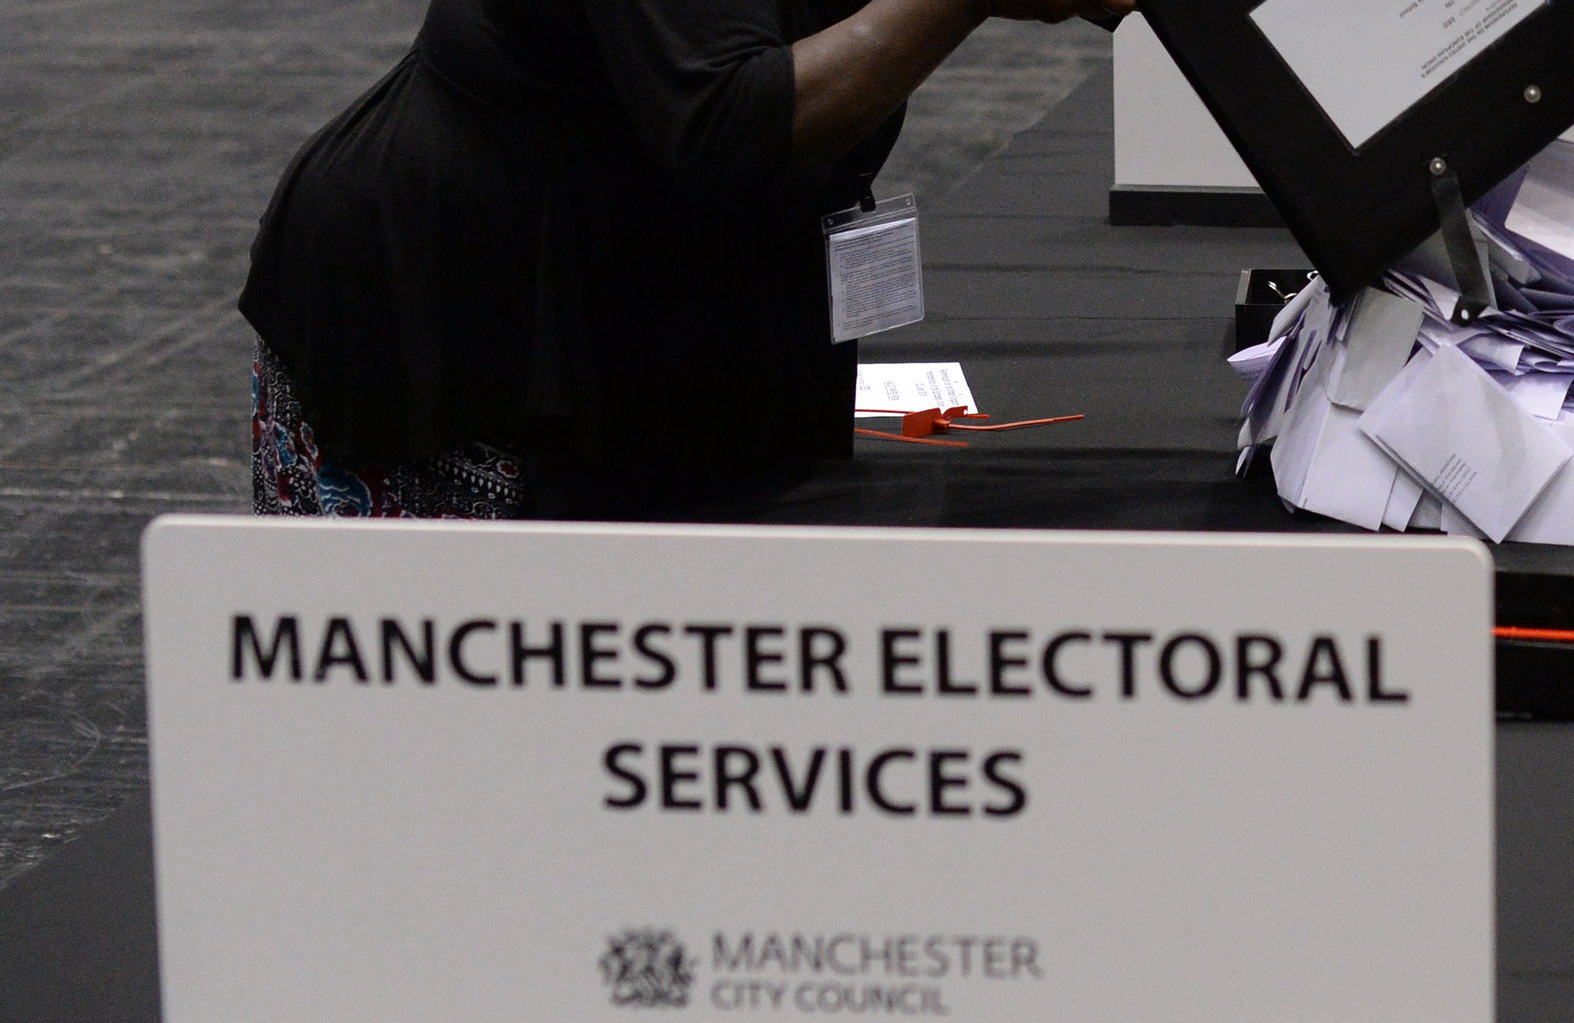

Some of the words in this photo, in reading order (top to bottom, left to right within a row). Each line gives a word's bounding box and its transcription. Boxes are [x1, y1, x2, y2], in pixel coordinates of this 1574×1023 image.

[231, 611, 848, 693] MANCHESTER
[879, 626, 1410, 704] ELECTORAL
[602, 740, 1028, 817] SERVICES
[711, 930, 1043, 978] MANCHESTER
[710, 981, 786, 1012] CITY
[796, 983, 948, 1016] COUNCIL
